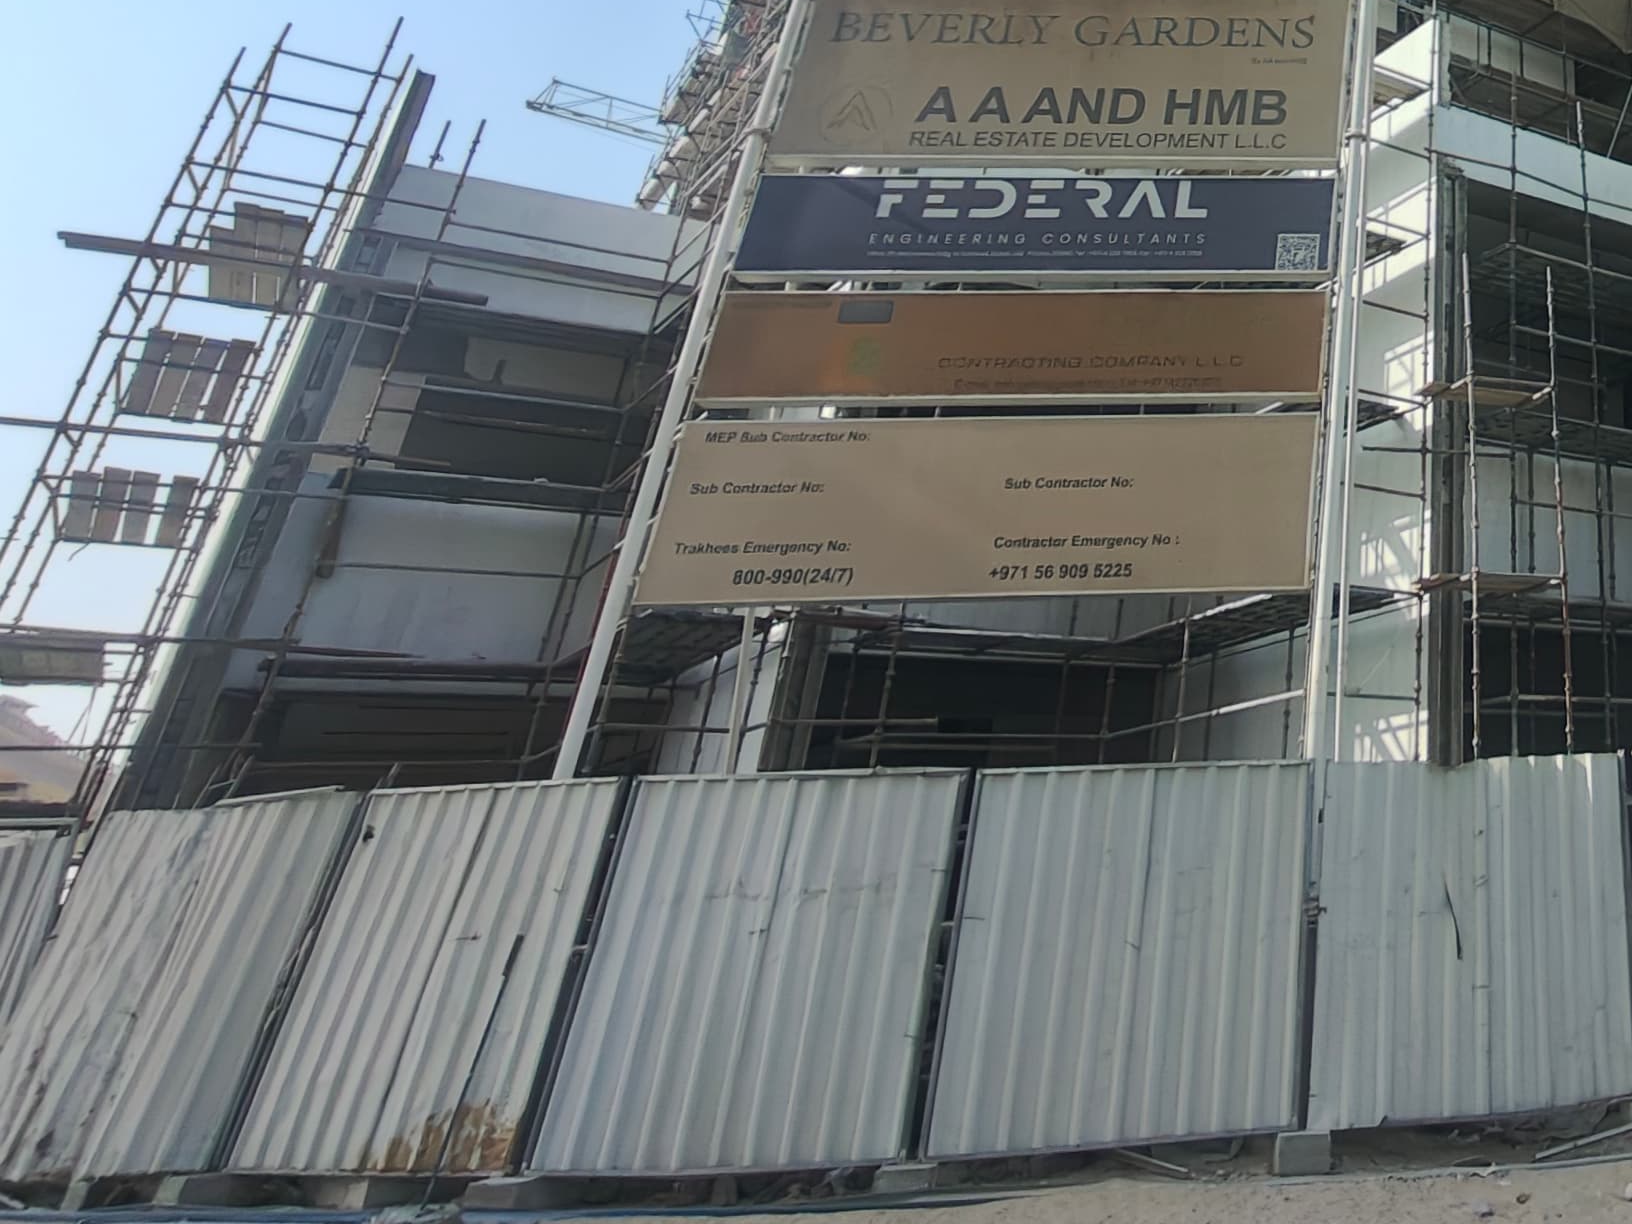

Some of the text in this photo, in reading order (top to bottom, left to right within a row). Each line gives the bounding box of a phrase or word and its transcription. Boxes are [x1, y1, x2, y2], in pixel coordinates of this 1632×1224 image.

[829, 11, 1316, 49] BEVERLY GARDENS
[1162, 88, 1288, 126] HMB
[908, 130, 969, 147] REAL
[973, 131, 1058, 148] ESTATE
[1063, 132, 1230, 149] DEVELOPMENT
[874, 179, 1209, 219] FEDERAL
[868, 232, 1207, 245] ENGINEERING CONSULTANTS
[705, 432, 737, 443] MEP
[771, 431, 844, 443] Contractor
[847, 430, 871, 442] No:
[690, 482, 825, 495] Sub Contractor No:
[1004, 476, 1134, 490] Sub Contractor No:
[742, 542, 823, 556] Emergency
[827, 540, 852, 552] No:
[994, 537, 1067, 549] Contractor
[1071, 535, 1148, 549] Emergency
[732, 568, 854, 586] 800-990(24/7)
[990, 563, 1133, 581] +971 56 909 5225
